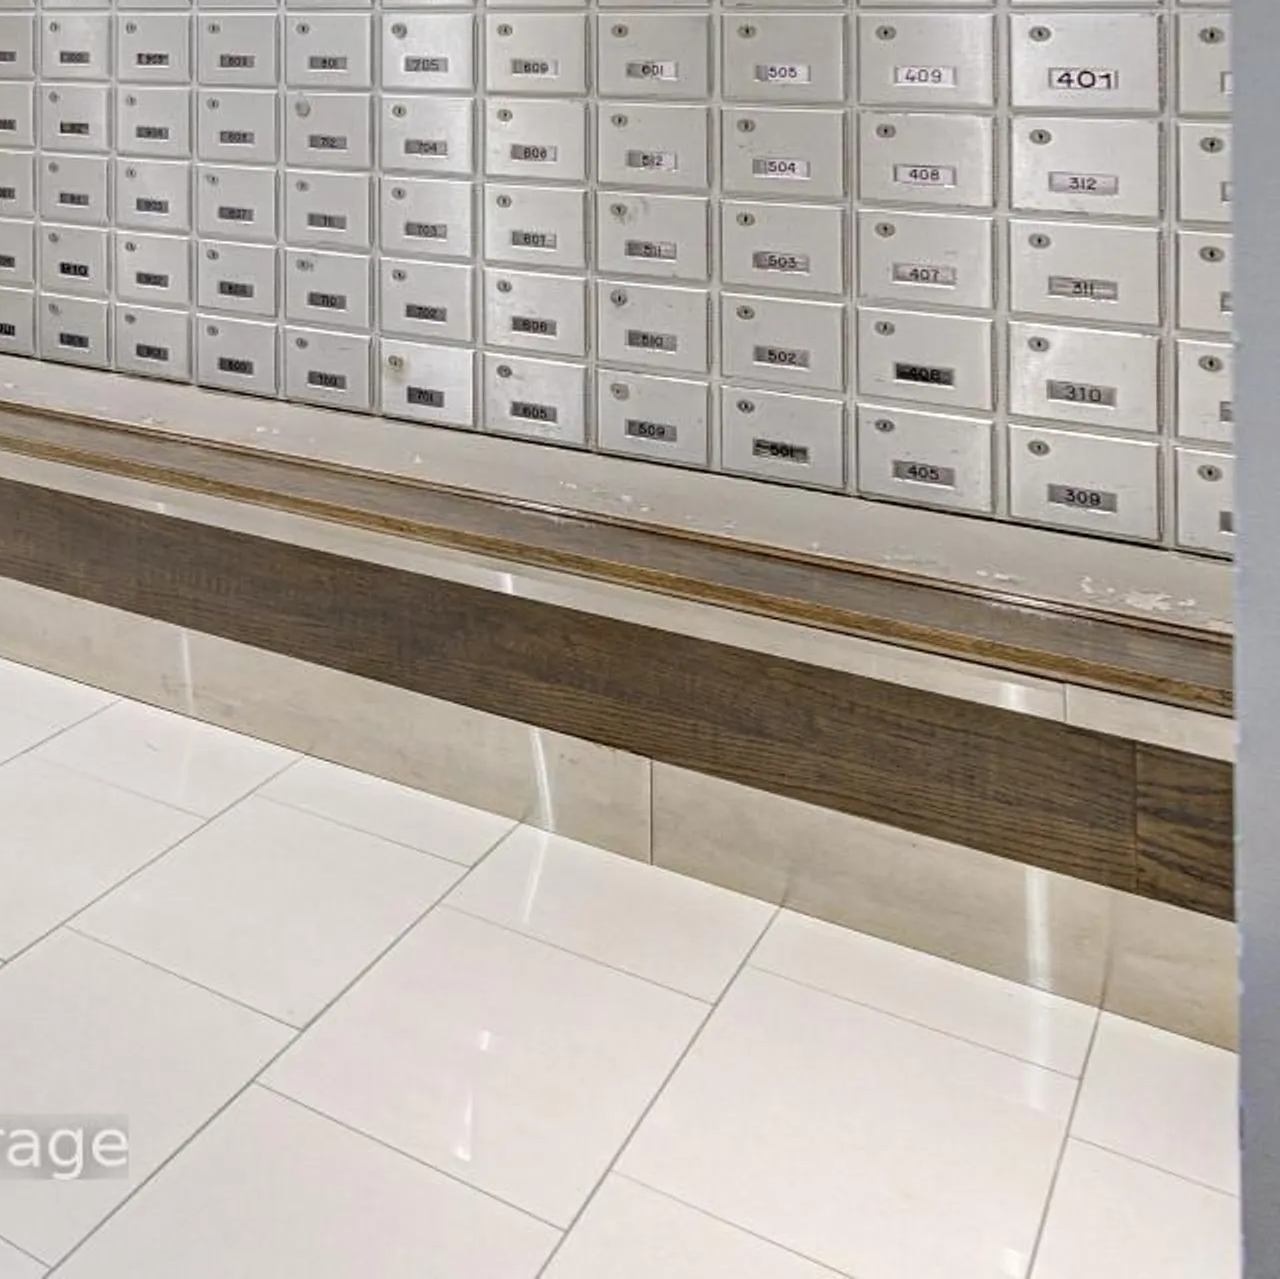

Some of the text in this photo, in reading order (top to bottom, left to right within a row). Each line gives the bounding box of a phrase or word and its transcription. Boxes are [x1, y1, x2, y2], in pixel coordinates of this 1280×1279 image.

[905, 69, 942, 84] 409
[1056, 71, 1112, 89] 401
[767, 161, 796, 173] 504
[909, 169, 940, 181] 408
[1069, 177, 1097, 191] 312
[767, 255, 797, 268] 503
[909, 268, 940, 281] 407
[1072, 281, 1094, 296] 311
[767, 350, 797, 364] 502
[1065, 385, 1102, 403] 310
[907, 465, 940, 481] 405
